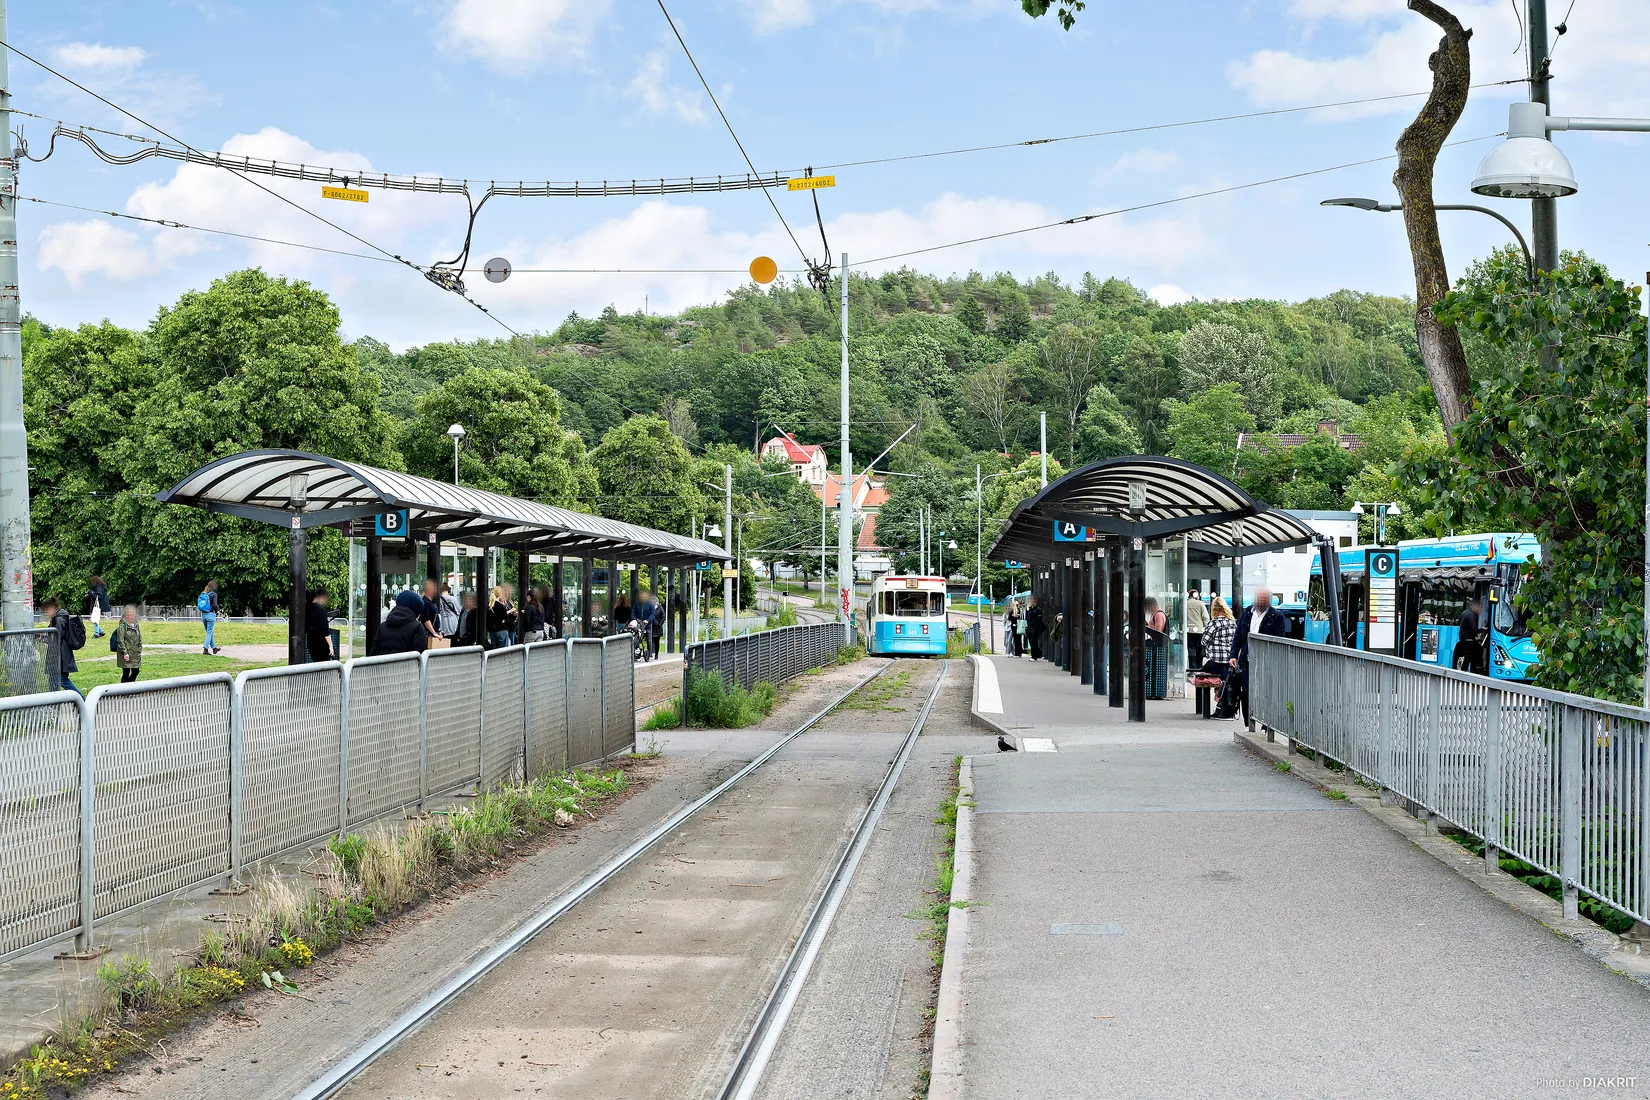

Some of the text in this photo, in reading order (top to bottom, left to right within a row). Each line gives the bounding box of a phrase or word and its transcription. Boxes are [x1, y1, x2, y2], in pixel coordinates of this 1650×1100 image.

[386, 513, 397, 529] B
[1063, 522, 1076, 535] A
[1456, 542, 1479, 550] ELECTRIC
[1378, 557, 1387, 571] C
